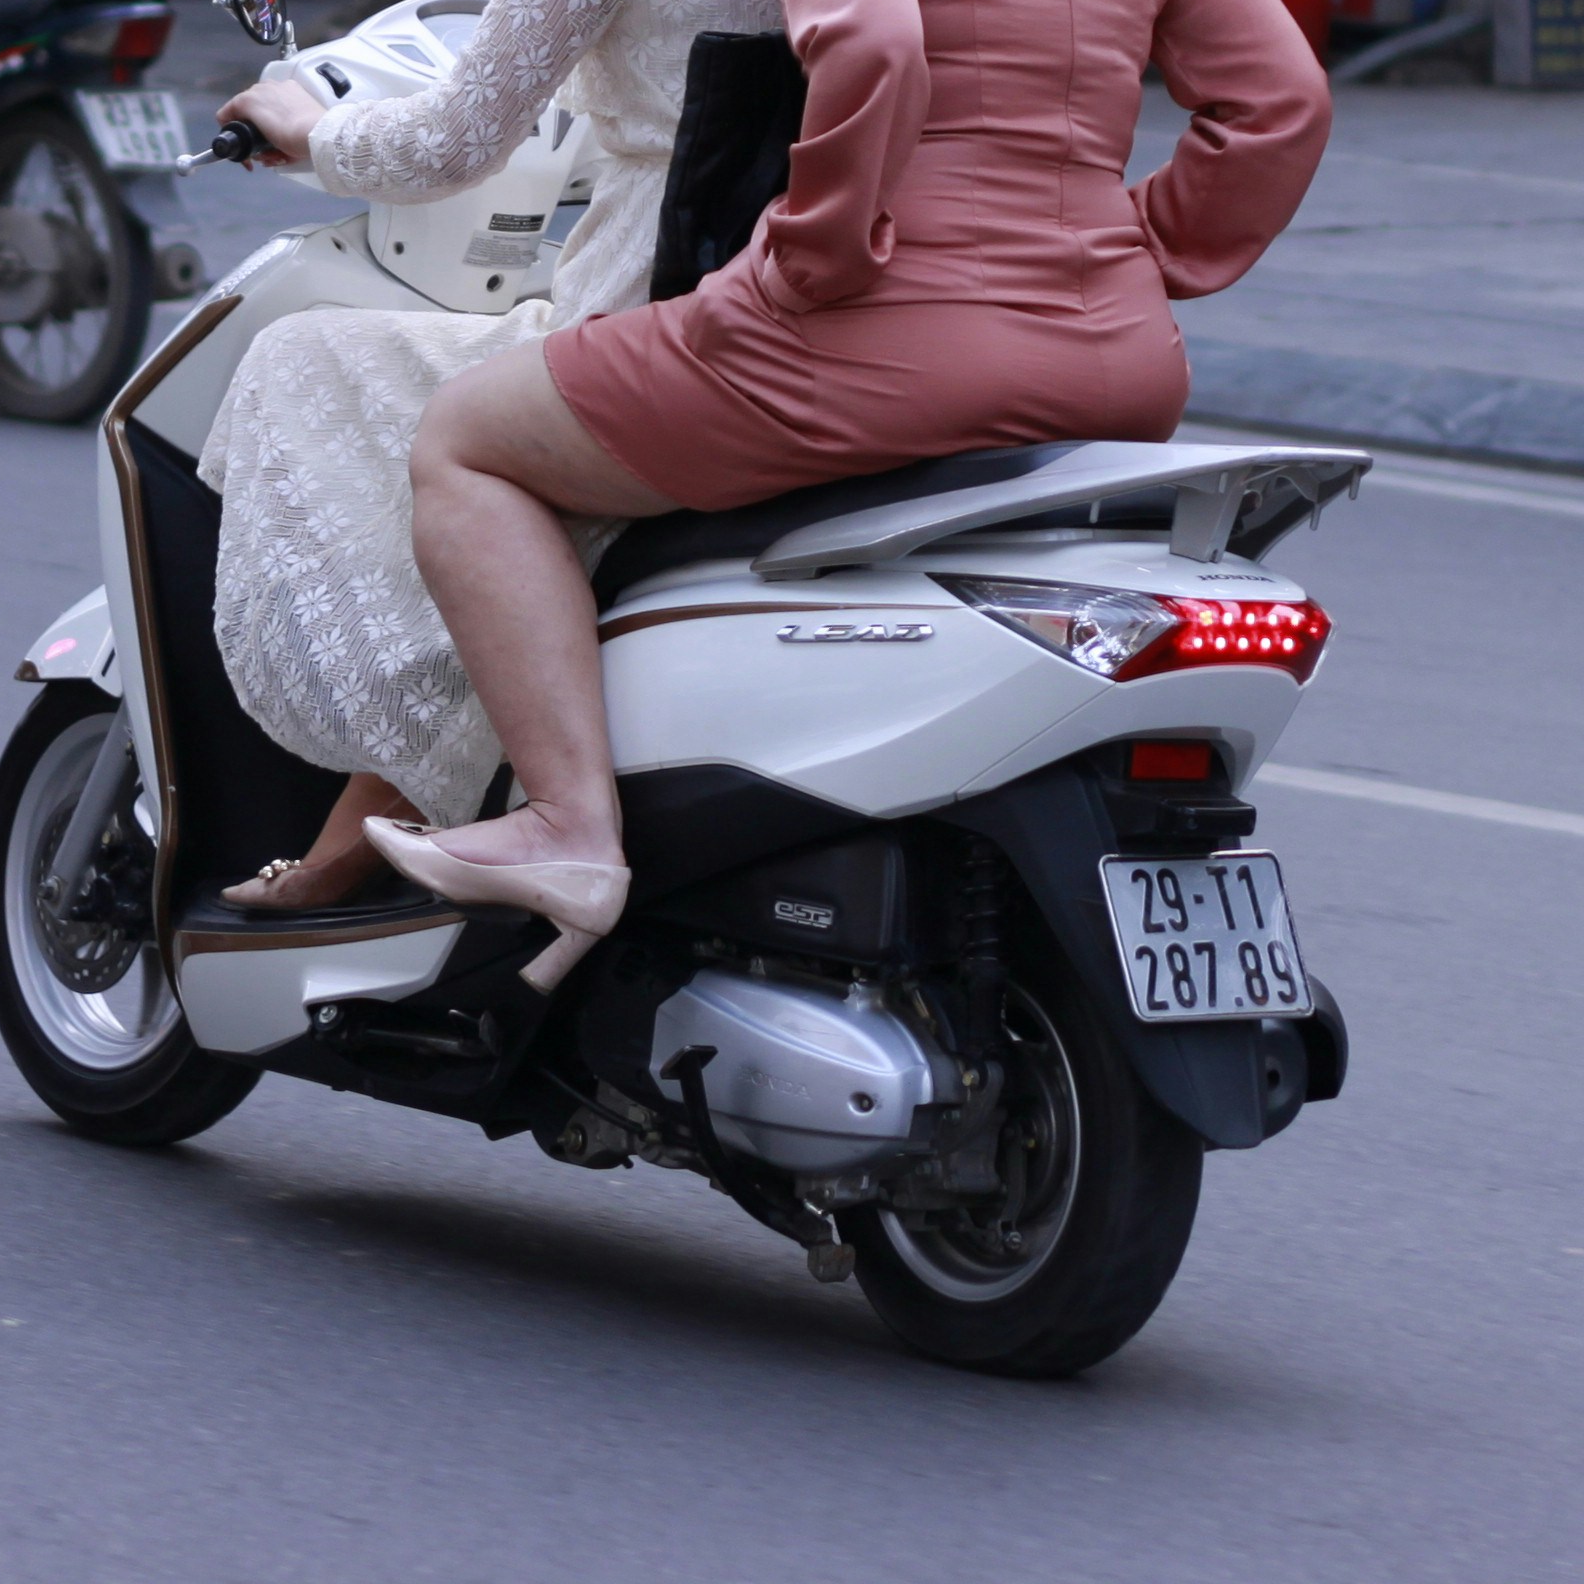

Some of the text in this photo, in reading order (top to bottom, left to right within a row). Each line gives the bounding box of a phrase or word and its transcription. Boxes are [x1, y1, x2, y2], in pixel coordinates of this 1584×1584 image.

[1196, 572, 1275, 584] HONDA
[774, 622, 936, 644] LEAD
[1130, 864, 1265, 936] 29-T1
[1133, 939, 1298, 1013] 287.89
